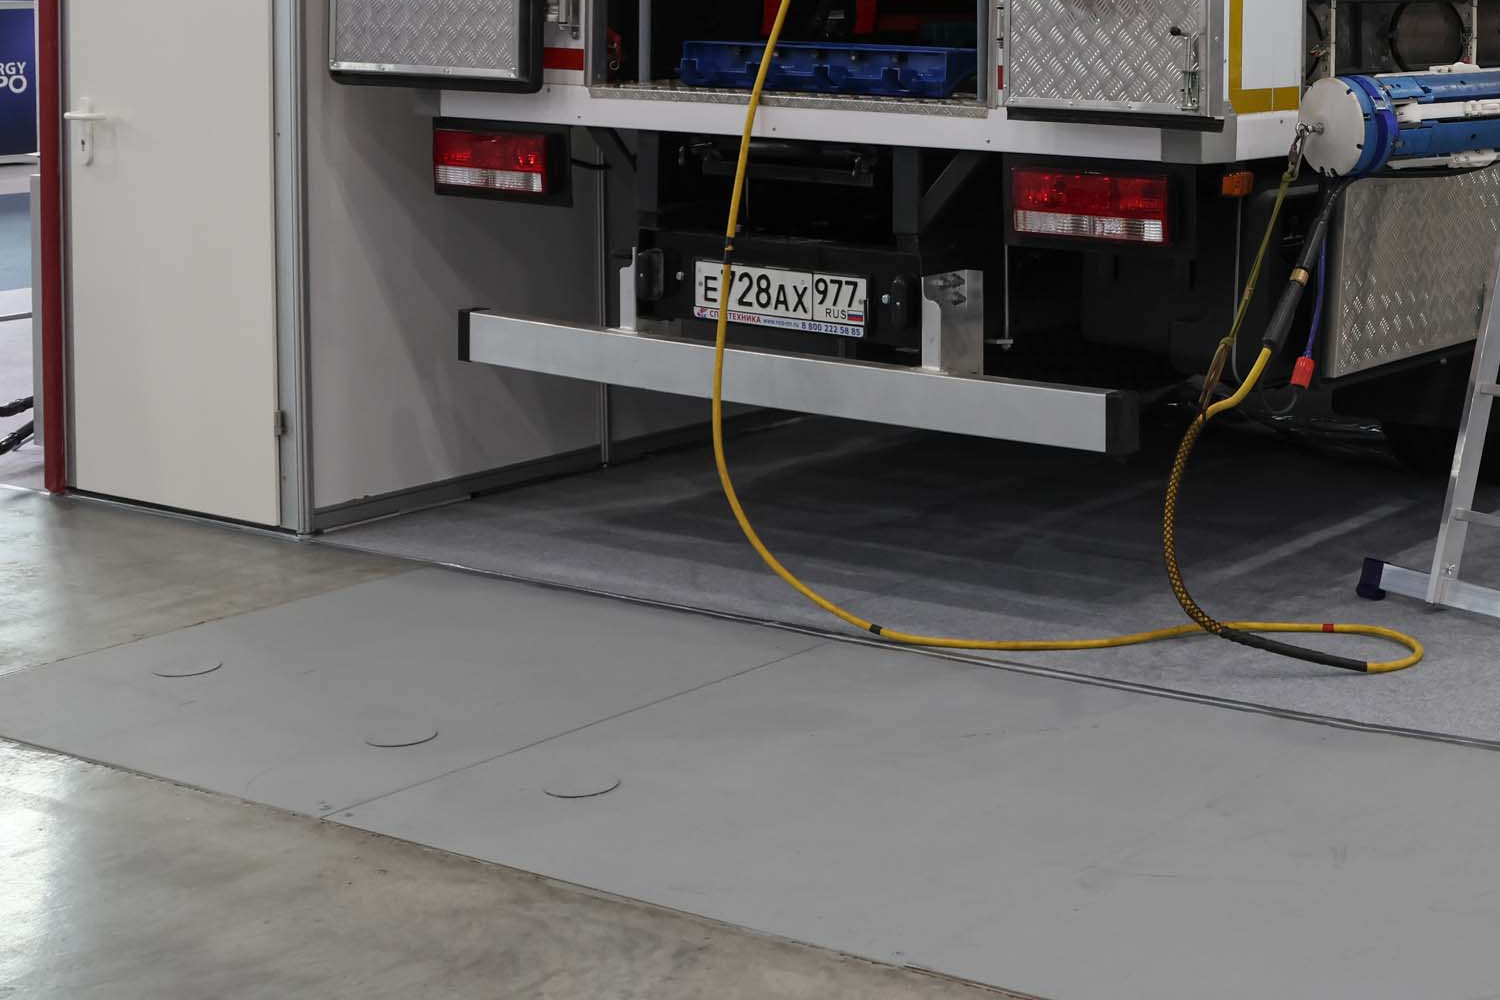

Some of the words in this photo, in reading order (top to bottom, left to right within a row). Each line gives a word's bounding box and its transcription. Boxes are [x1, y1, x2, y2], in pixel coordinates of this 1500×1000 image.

[814, 278, 858, 308] 977
[709, 310, 762, 324] СПТЕХНИКА
[801, 321, 807, 330] 8
[808, 322, 822, 332] 800
[824, 324, 838, 334] 222
[825, 307, 847, 320] RUS
